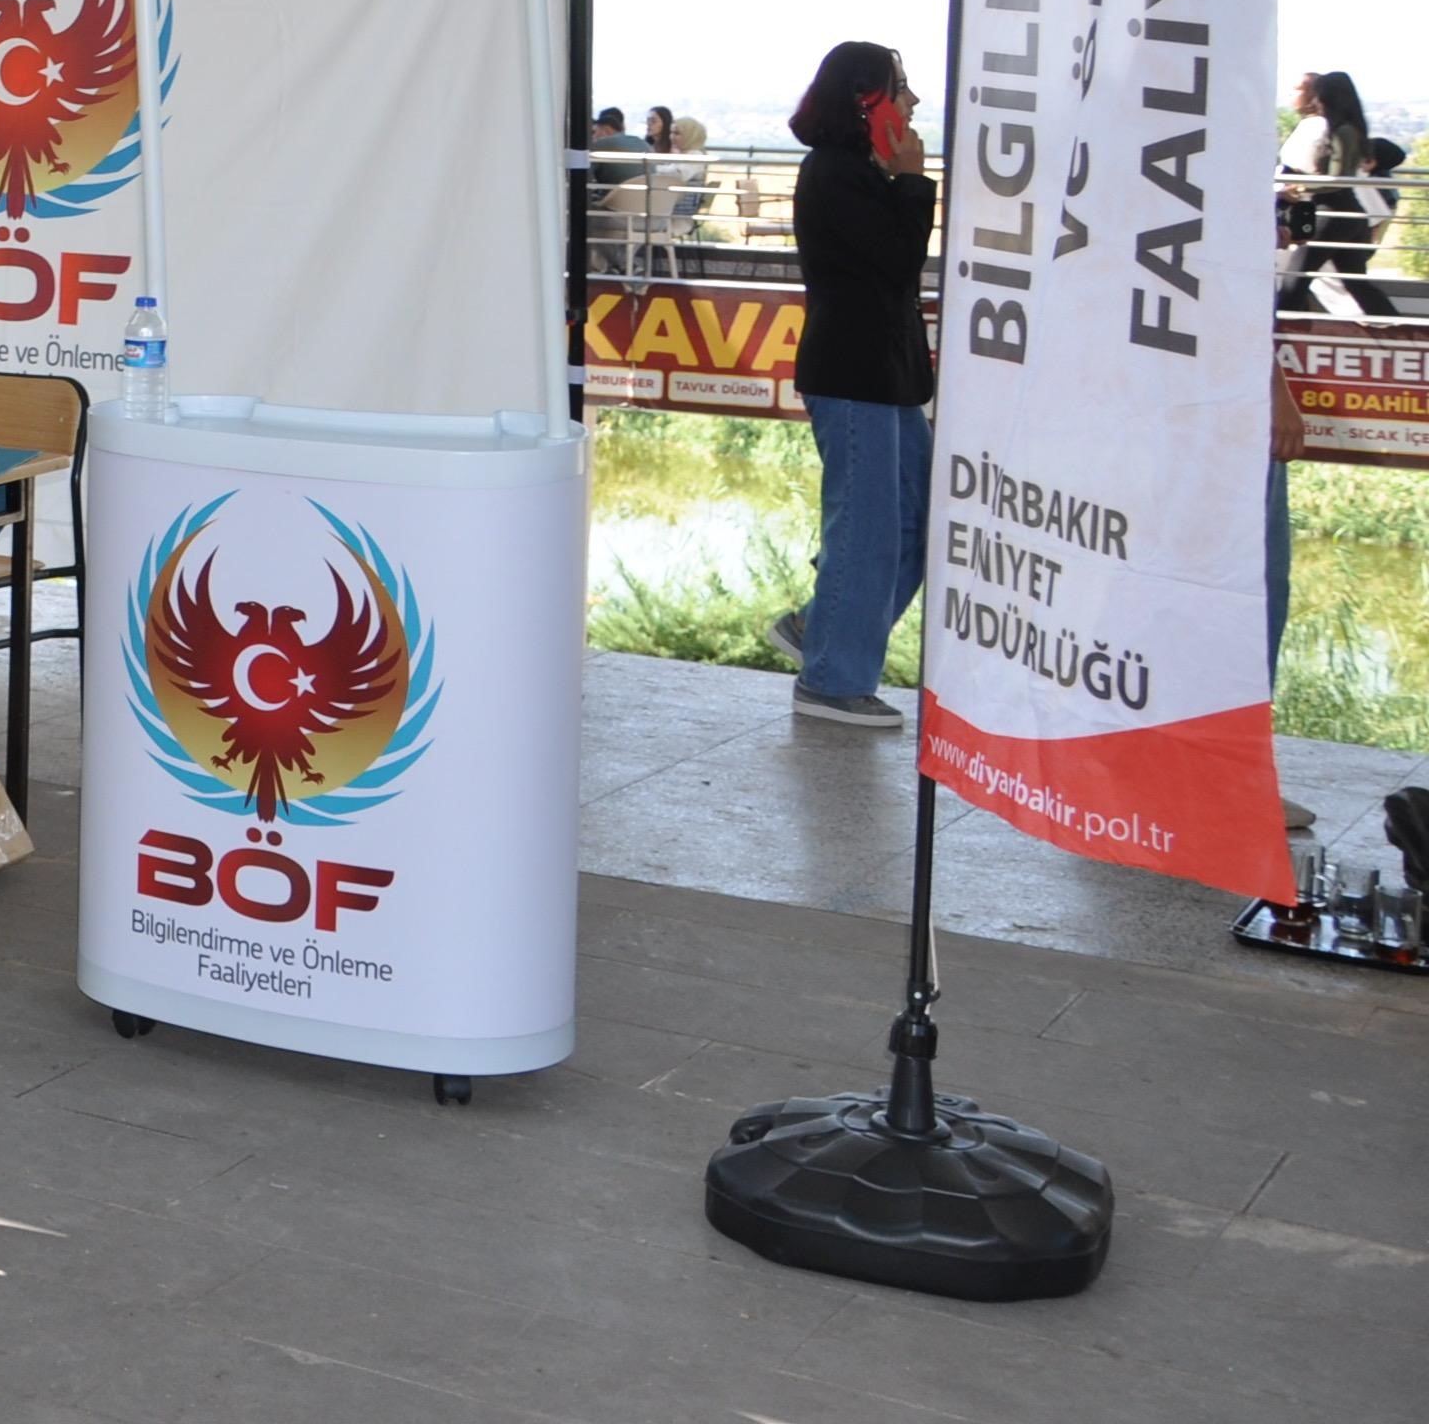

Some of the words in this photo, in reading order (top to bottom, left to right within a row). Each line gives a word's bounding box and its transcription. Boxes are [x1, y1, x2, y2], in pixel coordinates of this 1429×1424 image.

[15, 345, 39, 364] ve
[46, 334, 125, 372] Önleme
[1276, 343, 1429, 382] AFETE
[585, 373, 655, 389] MBURGER
[675, 380, 717, 395] TAVUK
[721, 382, 769, 397] DÜRÜM
[1301, 390, 1336, 408] 80
[927, 733, 1175, 853] www.diyarbakir.pol.tr
[136, 826, 396, 933] BÖF
[131, 909, 264, 961] Bilgilendirme
[269, 944, 296, 967] ve
[302, 937, 394, 983] Önleme
[197, 953, 312, 1000] Faaliyetleri
